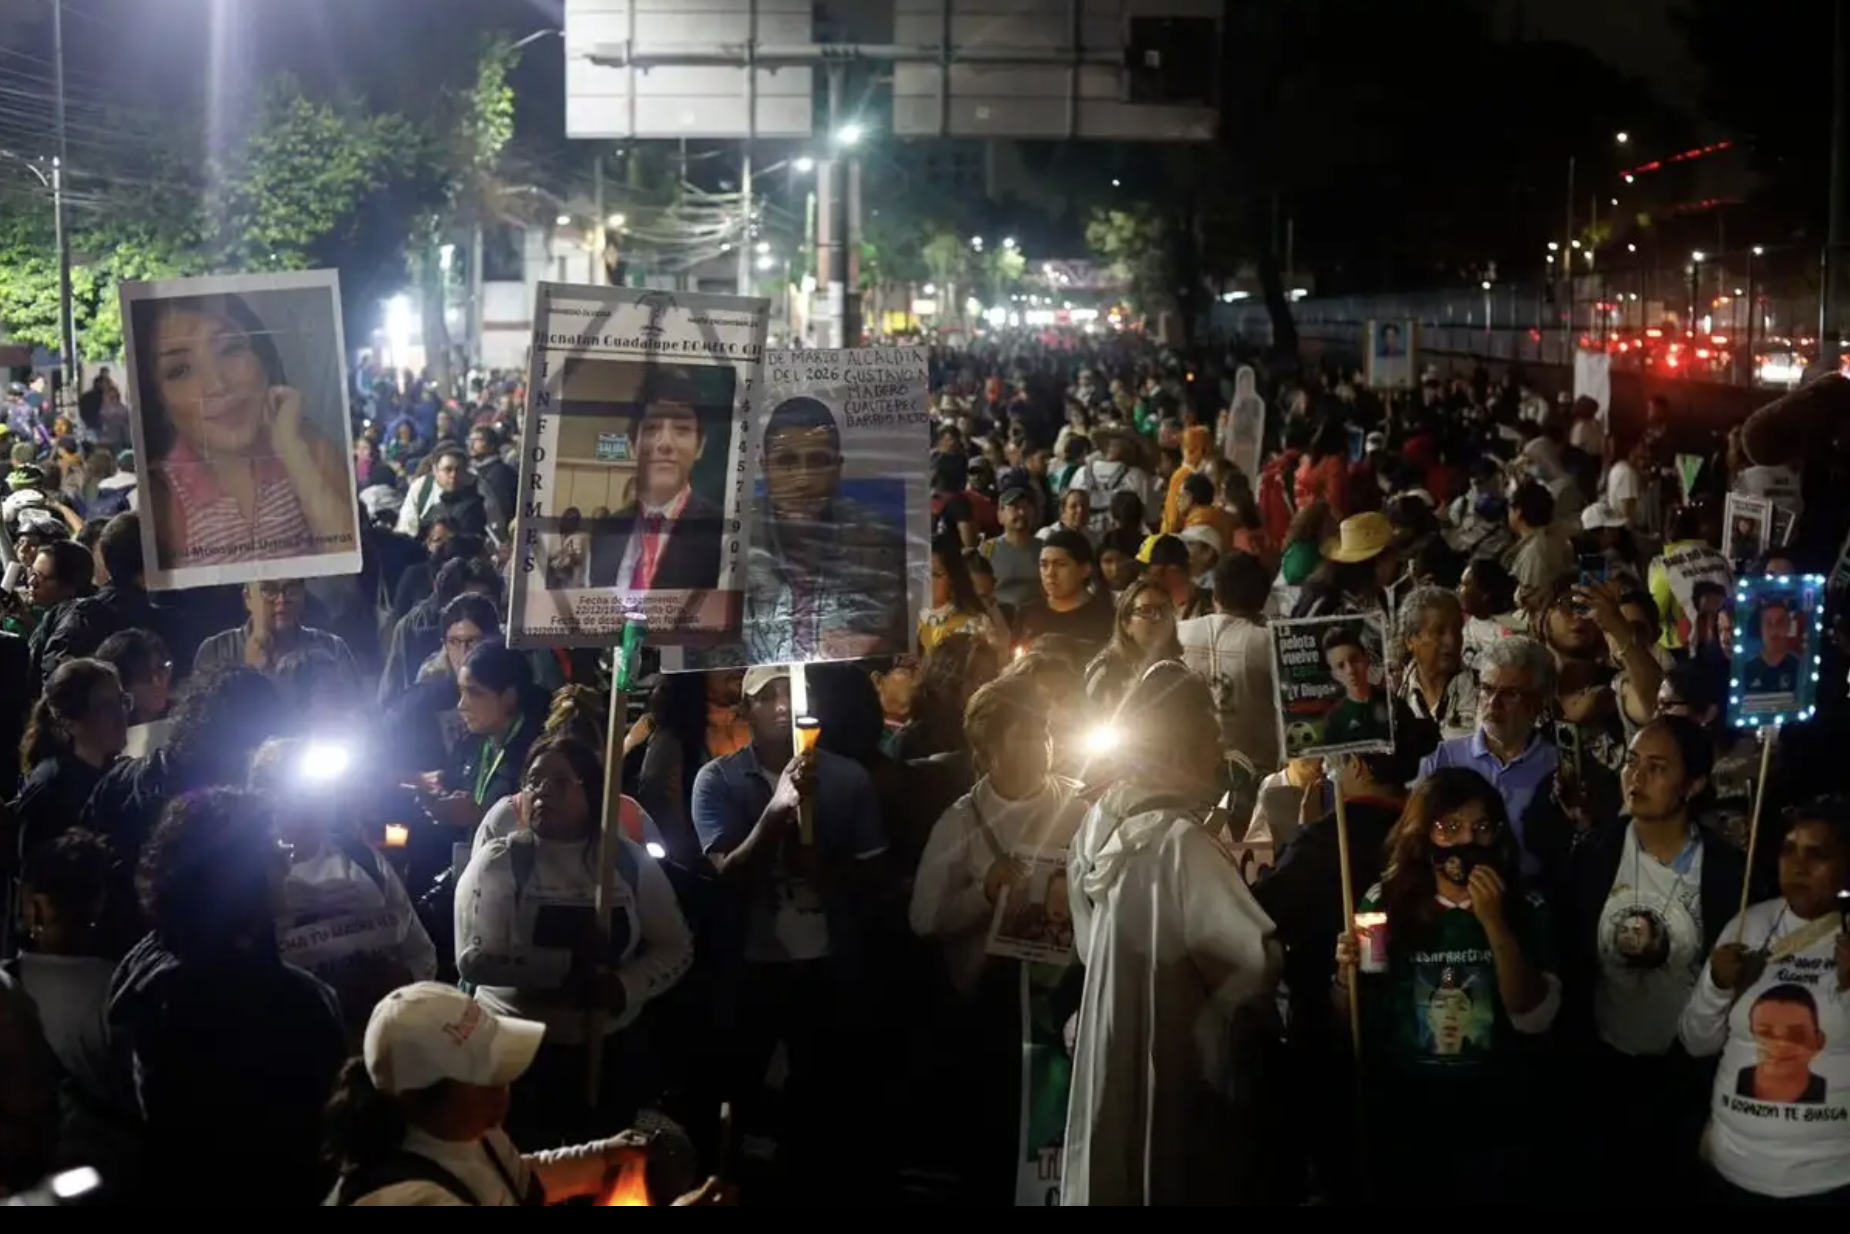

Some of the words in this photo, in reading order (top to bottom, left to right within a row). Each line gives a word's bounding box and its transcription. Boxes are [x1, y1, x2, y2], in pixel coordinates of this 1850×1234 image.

[603, 334, 678, 351] Guadalupe
[768, 352, 783, 366] DE
[791, 351, 840, 364] MARZO
[773, 368, 799, 383] DEL
[806, 366, 840, 381] 2026
[843, 367, 914, 384] GUSTAVO
[847, 384, 909, 399] MADERO
[846, 413, 895, 428] BARRIO
[523, 361, 550, 573] INFORMES
[579, 595, 608, 606] Fecha
[583, 615, 597, 625] de
[1280, 633, 1317, 651] pelota
